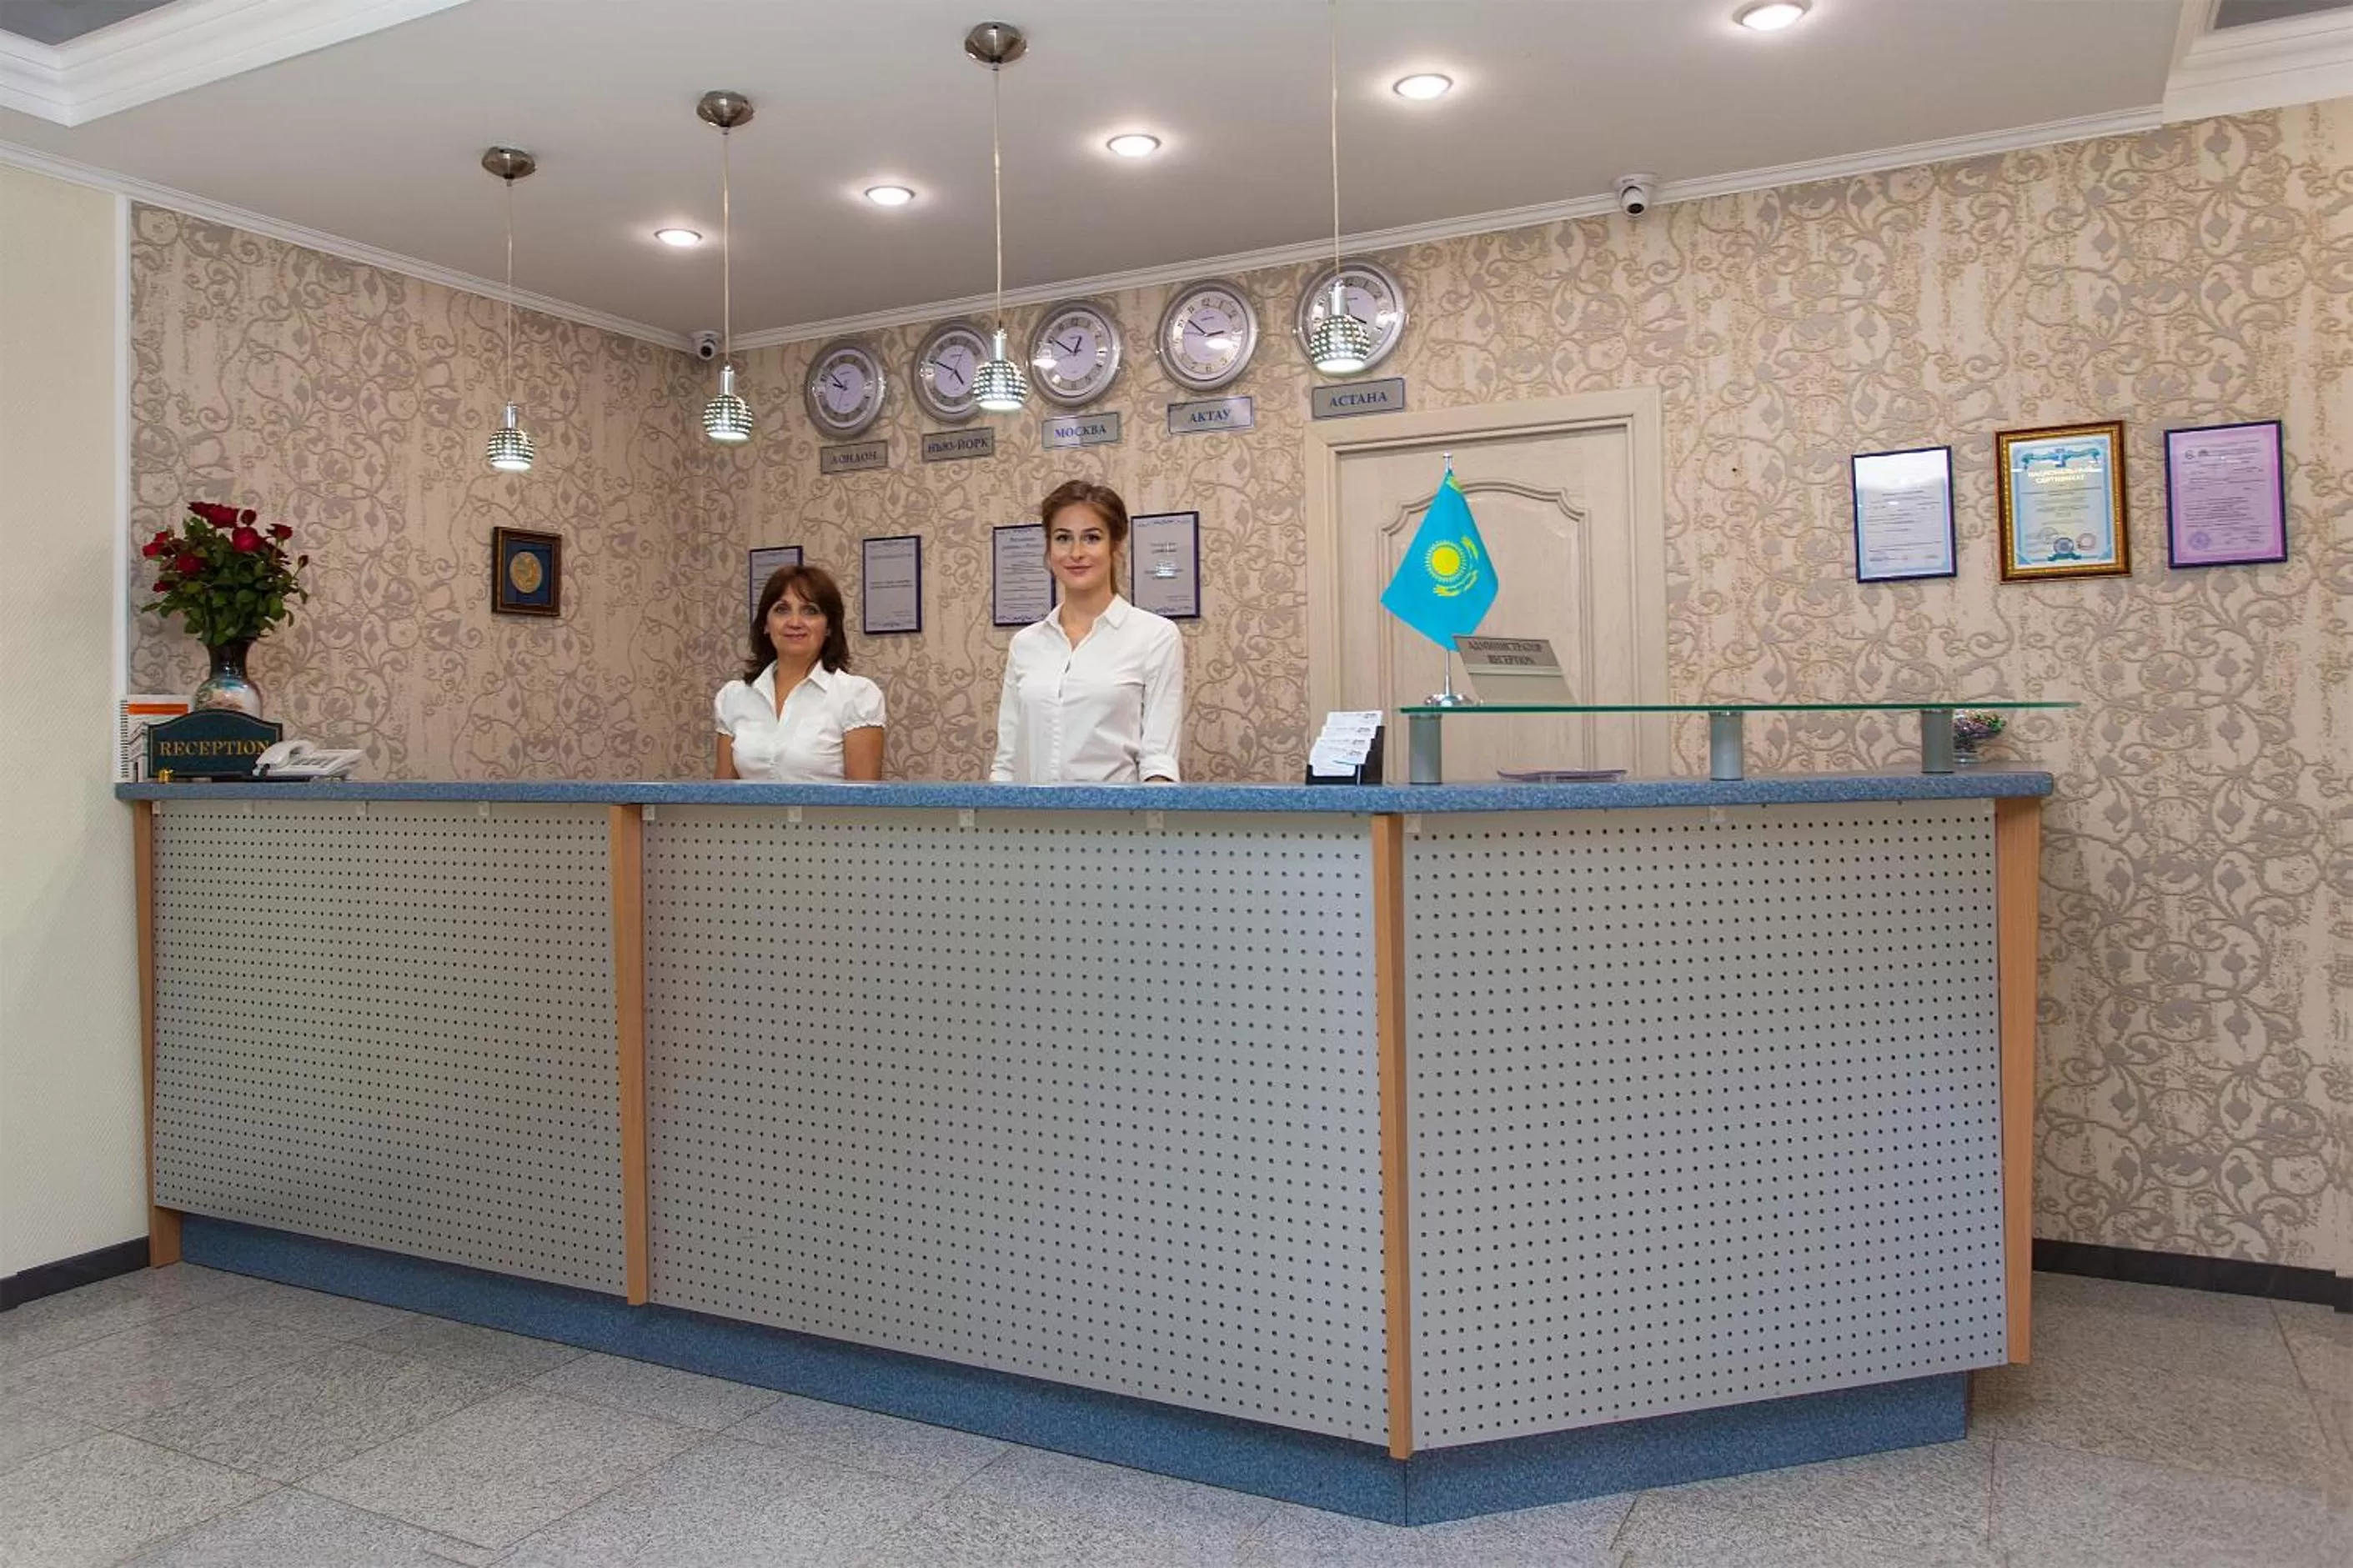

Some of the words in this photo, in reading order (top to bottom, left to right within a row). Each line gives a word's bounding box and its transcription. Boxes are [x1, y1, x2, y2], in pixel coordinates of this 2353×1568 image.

[1330, 391, 1388, 408] АСТАНА
[1190, 408, 1232, 423] АКТАУ
[1054, 423, 1107, 439] МОСКВА
[158, 739, 270, 757] RECEPTION
